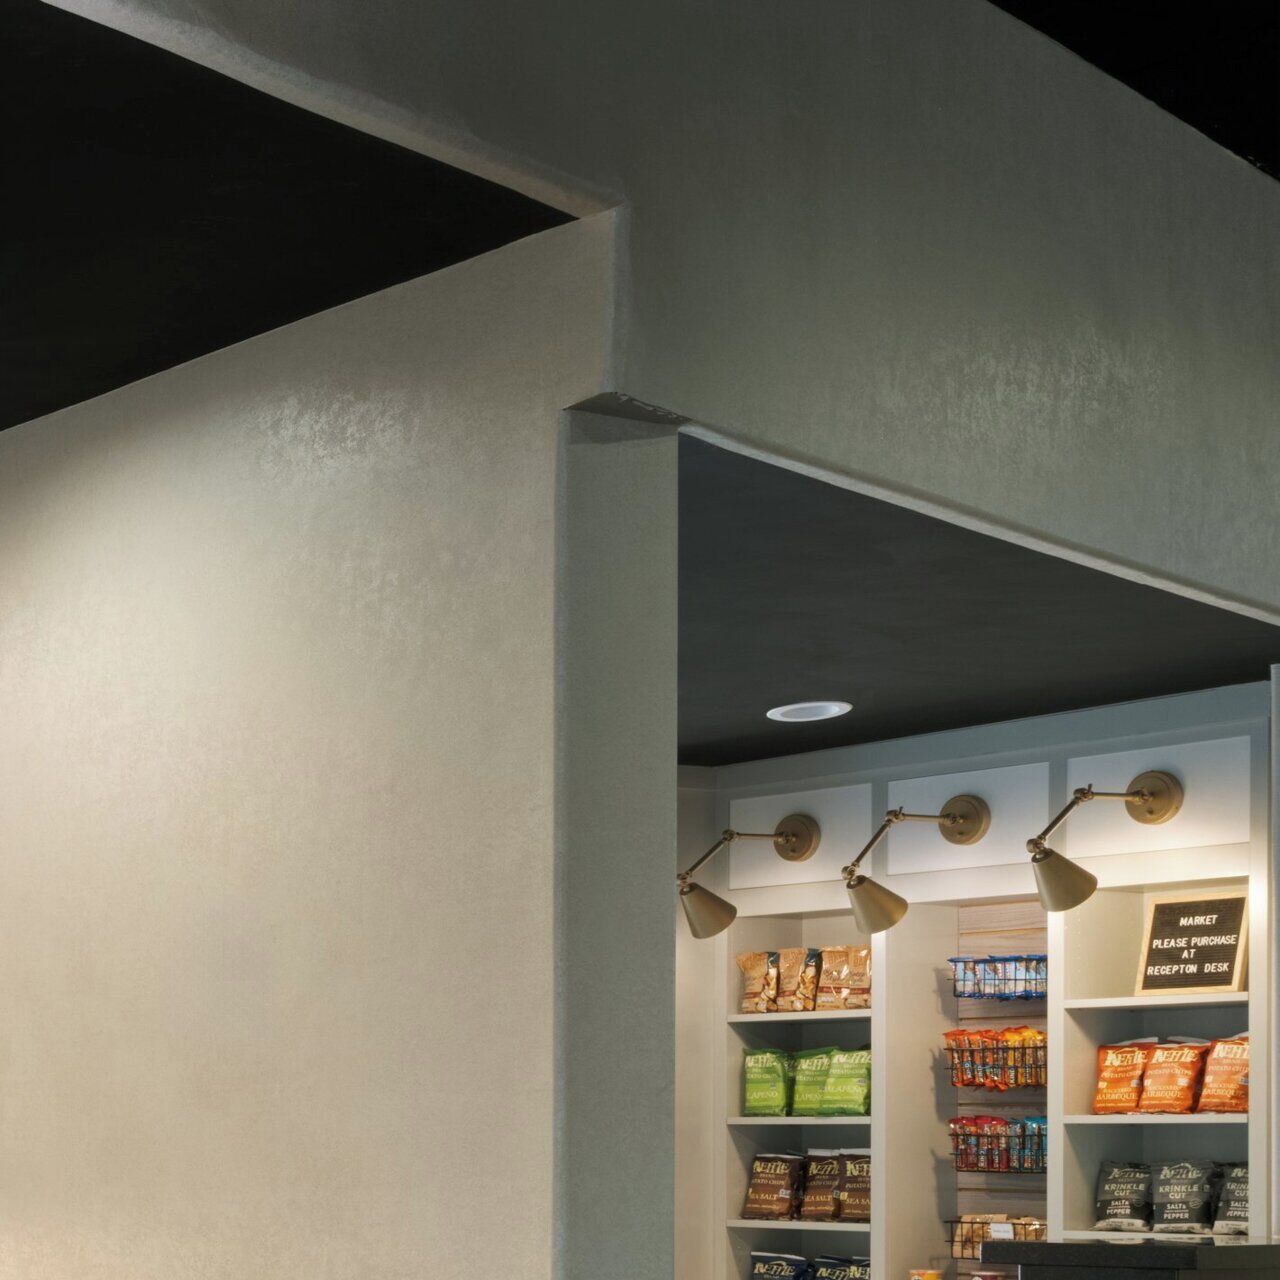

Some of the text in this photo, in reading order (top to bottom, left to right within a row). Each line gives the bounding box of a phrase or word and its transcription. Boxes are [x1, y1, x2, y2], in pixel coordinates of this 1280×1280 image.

[1179, 915, 1218, 927] MARKET
[1152, 934, 1238, 949] PLEASE PURCHASE
[1181, 949, 1196, 959] AT
[1146, 962, 1229, 976] RECEPTON DESK
[1104, 1183, 1145, 1191] KRINKLE
[1159, 1185, 1199, 1193] KRINKLE
